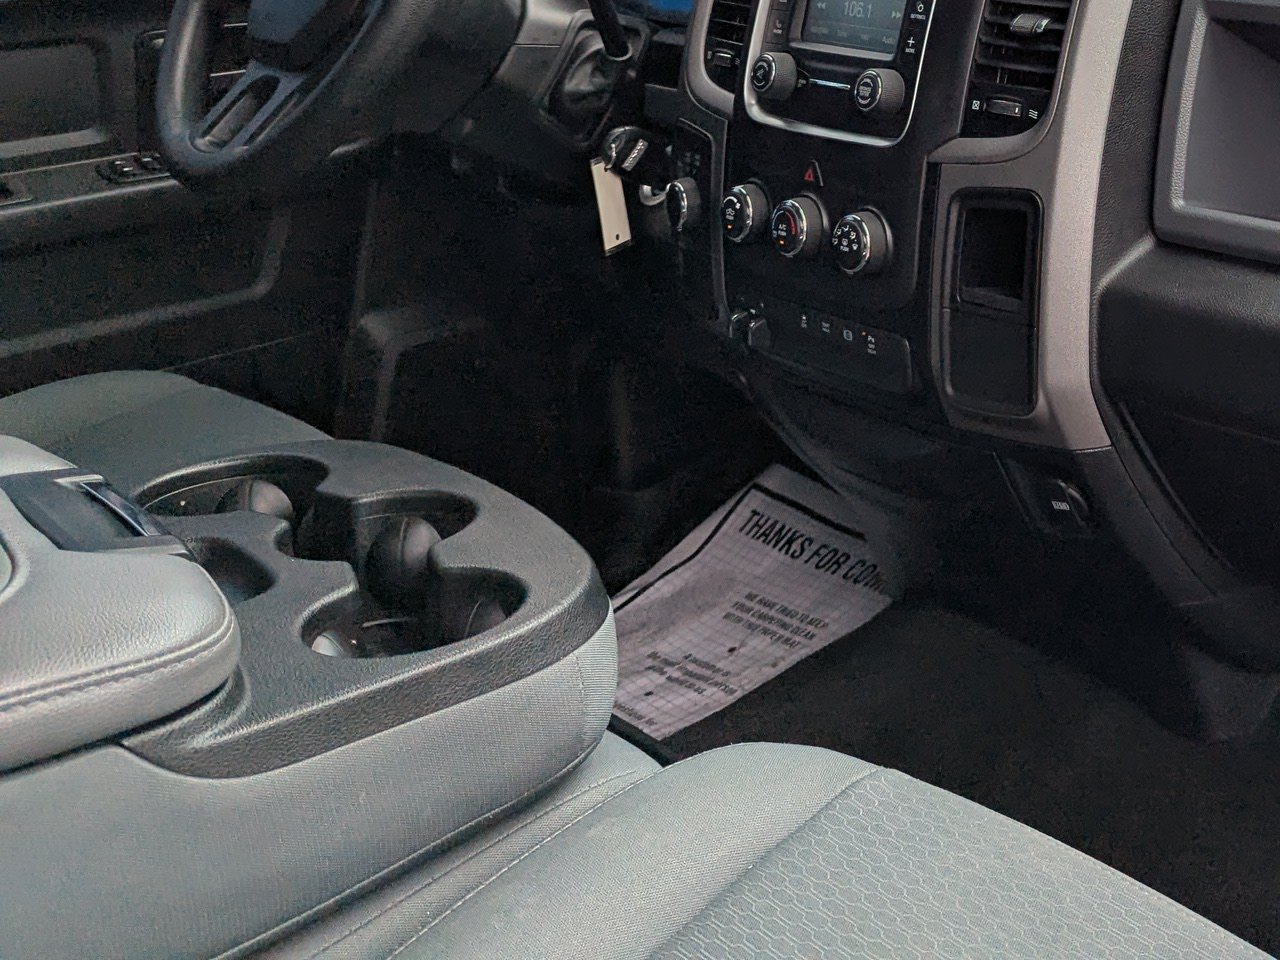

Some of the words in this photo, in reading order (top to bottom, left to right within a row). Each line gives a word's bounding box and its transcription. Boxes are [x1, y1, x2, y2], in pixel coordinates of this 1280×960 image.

[843, 0, 872, 19] 106.1
[738, 508, 814, 559] THANKS
[804, 543, 851, 575] FOR
